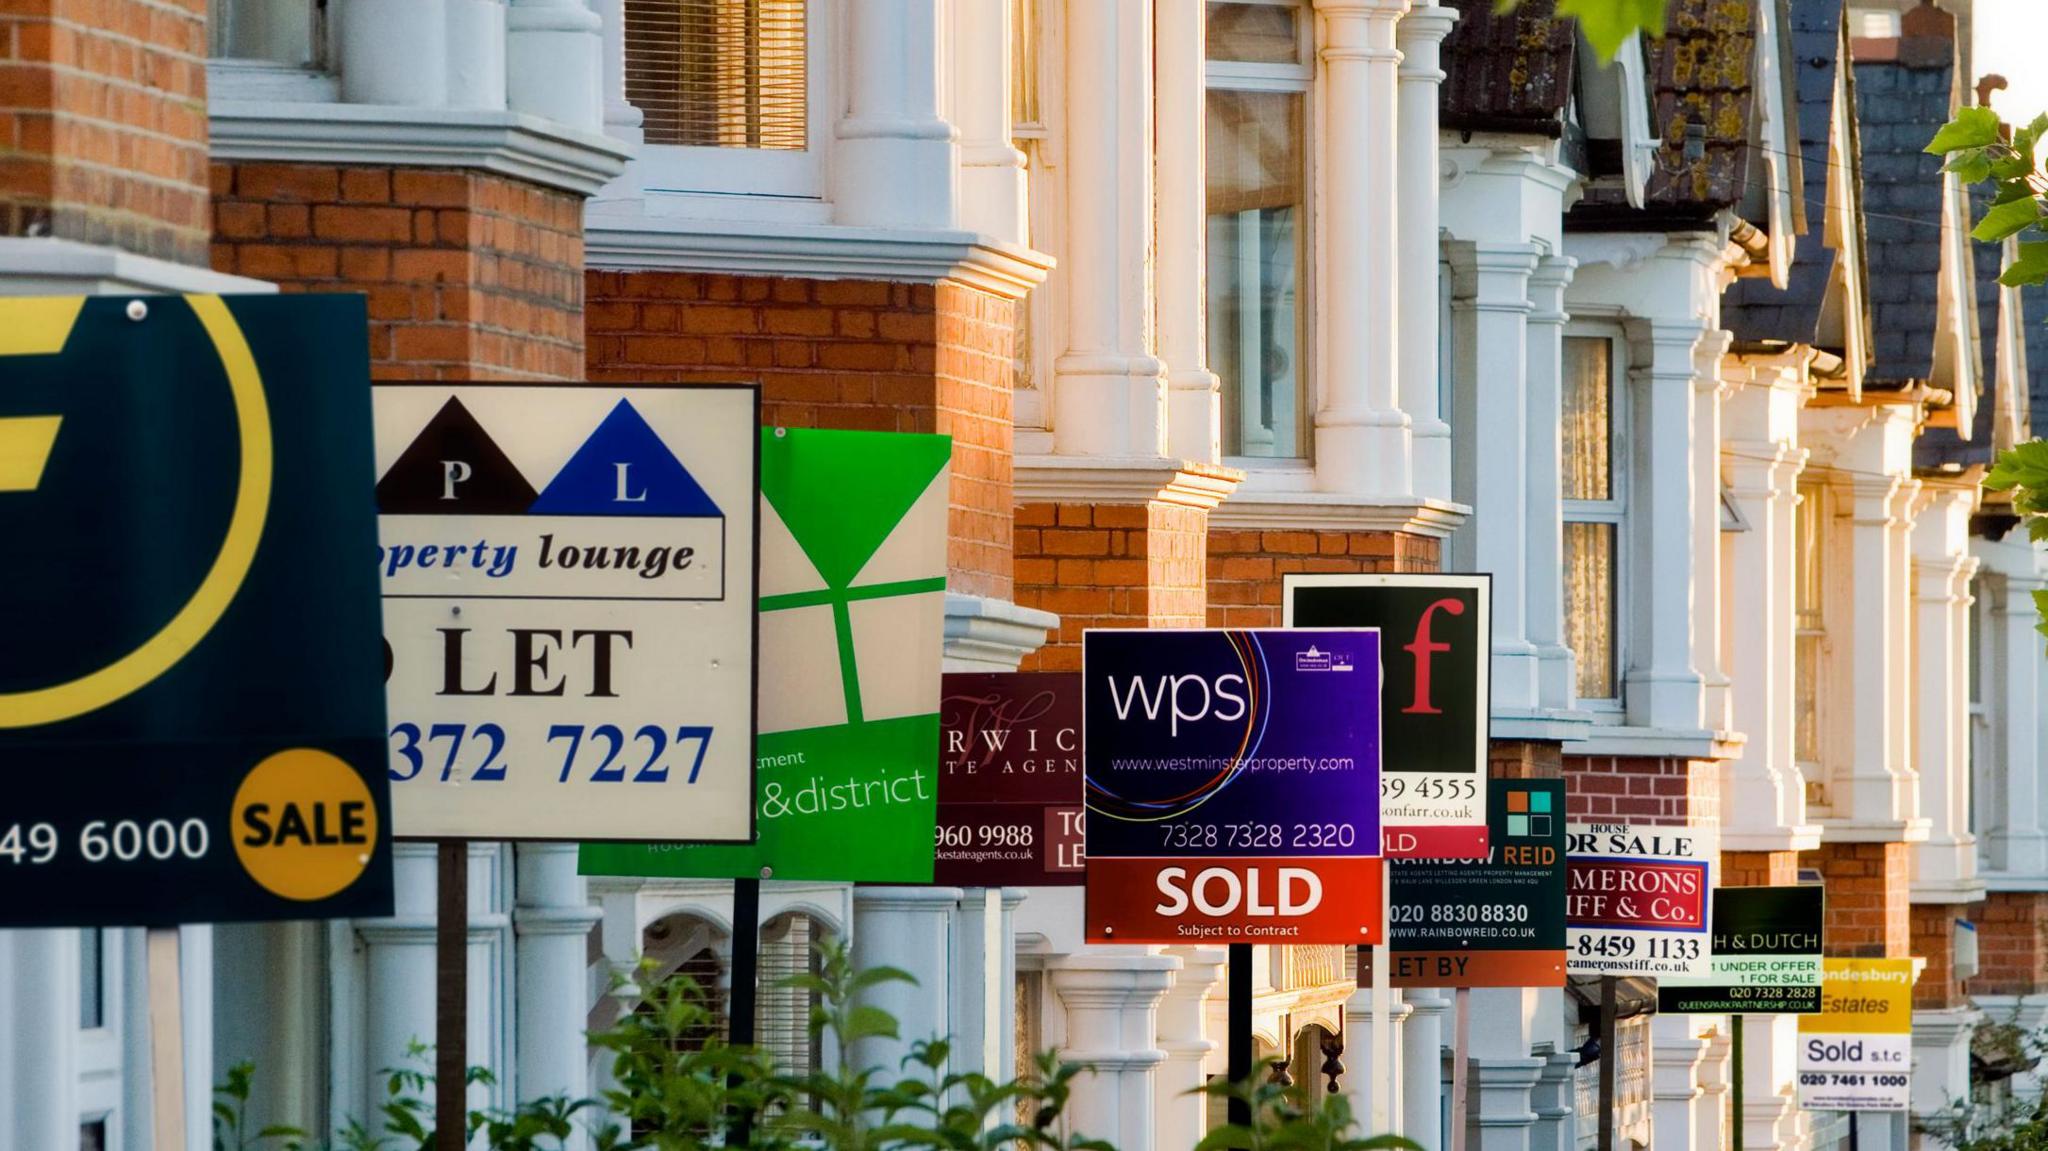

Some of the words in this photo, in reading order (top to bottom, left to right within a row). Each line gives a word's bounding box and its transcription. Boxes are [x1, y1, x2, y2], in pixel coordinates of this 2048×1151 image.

[440, 460, 472, 499] P
[612, 462, 647, 501] L
[538, 533, 695, 579] lounge
[435, 627, 633, 698] LET
[1402, 598, 1464, 714] f
[1108, 674, 1246, 736] wps
[947, 728, 1076, 753] RWIC
[387, 722, 508, 782] 372
[546, 724, 714, 784] 7227
[946, 760, 977, 774] TE
[1002, 759, 1078, 773] AGEN
[1111, 755, 1354, 774] www.westminsterproperty.com
[756, 769, 930, 819] &district
[1415, 777, 1476, 800] 4555
[242, 801, 367, 848] SALE
[1160, 825, 1218, 847] 7328
[1224, 824, 1282, 847] 7328
[1293, 823, 1355, 847] 2320
[1590, 824, 1630, 834] HOUSE
[0, 822, 58, 864] 49
[80, 819, 210, 862] 6000
[935, 825, 972, 846] 960
[979, 825, 1033, 846] 9988
[1382, 834, 1417, 852] LD
[1609, 835, 1693, 857] SALE
[934, 849, 1033, 862] kestateagents.co.uk
[1504, 846, 1556, 865] REID
[1155, 867, 1322, 917] SOLD
[1390, 904, 1424, 922] 020
[1431, 904, 1477, 922] 8830
[1481, 904, 1528, 922] 8830
[1616, 896, 1641, 918] &
[1651, 898, 1694, 920] Co.
[1178, 924, 1222, 936] Subject
[1227, 925, 1240, 935] to
[1244, 924, 1299, 935] Contract
[1389, 927, 1535, 938] WWW.RAINBOWREID.CO.UK
[1648, 937, 1699, 960] 1133
[1732, 935, 1746, 949] &
[1752, 933, 1817, 949] DUTCH
[1438, 957, 1469, 976] BY
[1567, 959, 1689, 972] cameronsstiff.co.uk
[1720, 962, 1767, 972] UNDER
[1771, 962, 1816, 972] OFFER
[1741, 975, 1745, 983] 1
[1750, 974, 1777, 984] FOR
[1782, 974, 1815, 984] SALE
[1730, 988, 1750, 998] 020
[1755, 988, 1783, 998] 7328
[1786, 988, 1816, 998] 2828
[1808, 1039, 1863, 1062] Sold
[1870, 1051, 1902, 1062] s.t.c
[1800, 1075, 1827, 1086] 020
[1831, 1075, 1866, 1086] 7461
[1872, 1075, 1907, 1087] 1000
